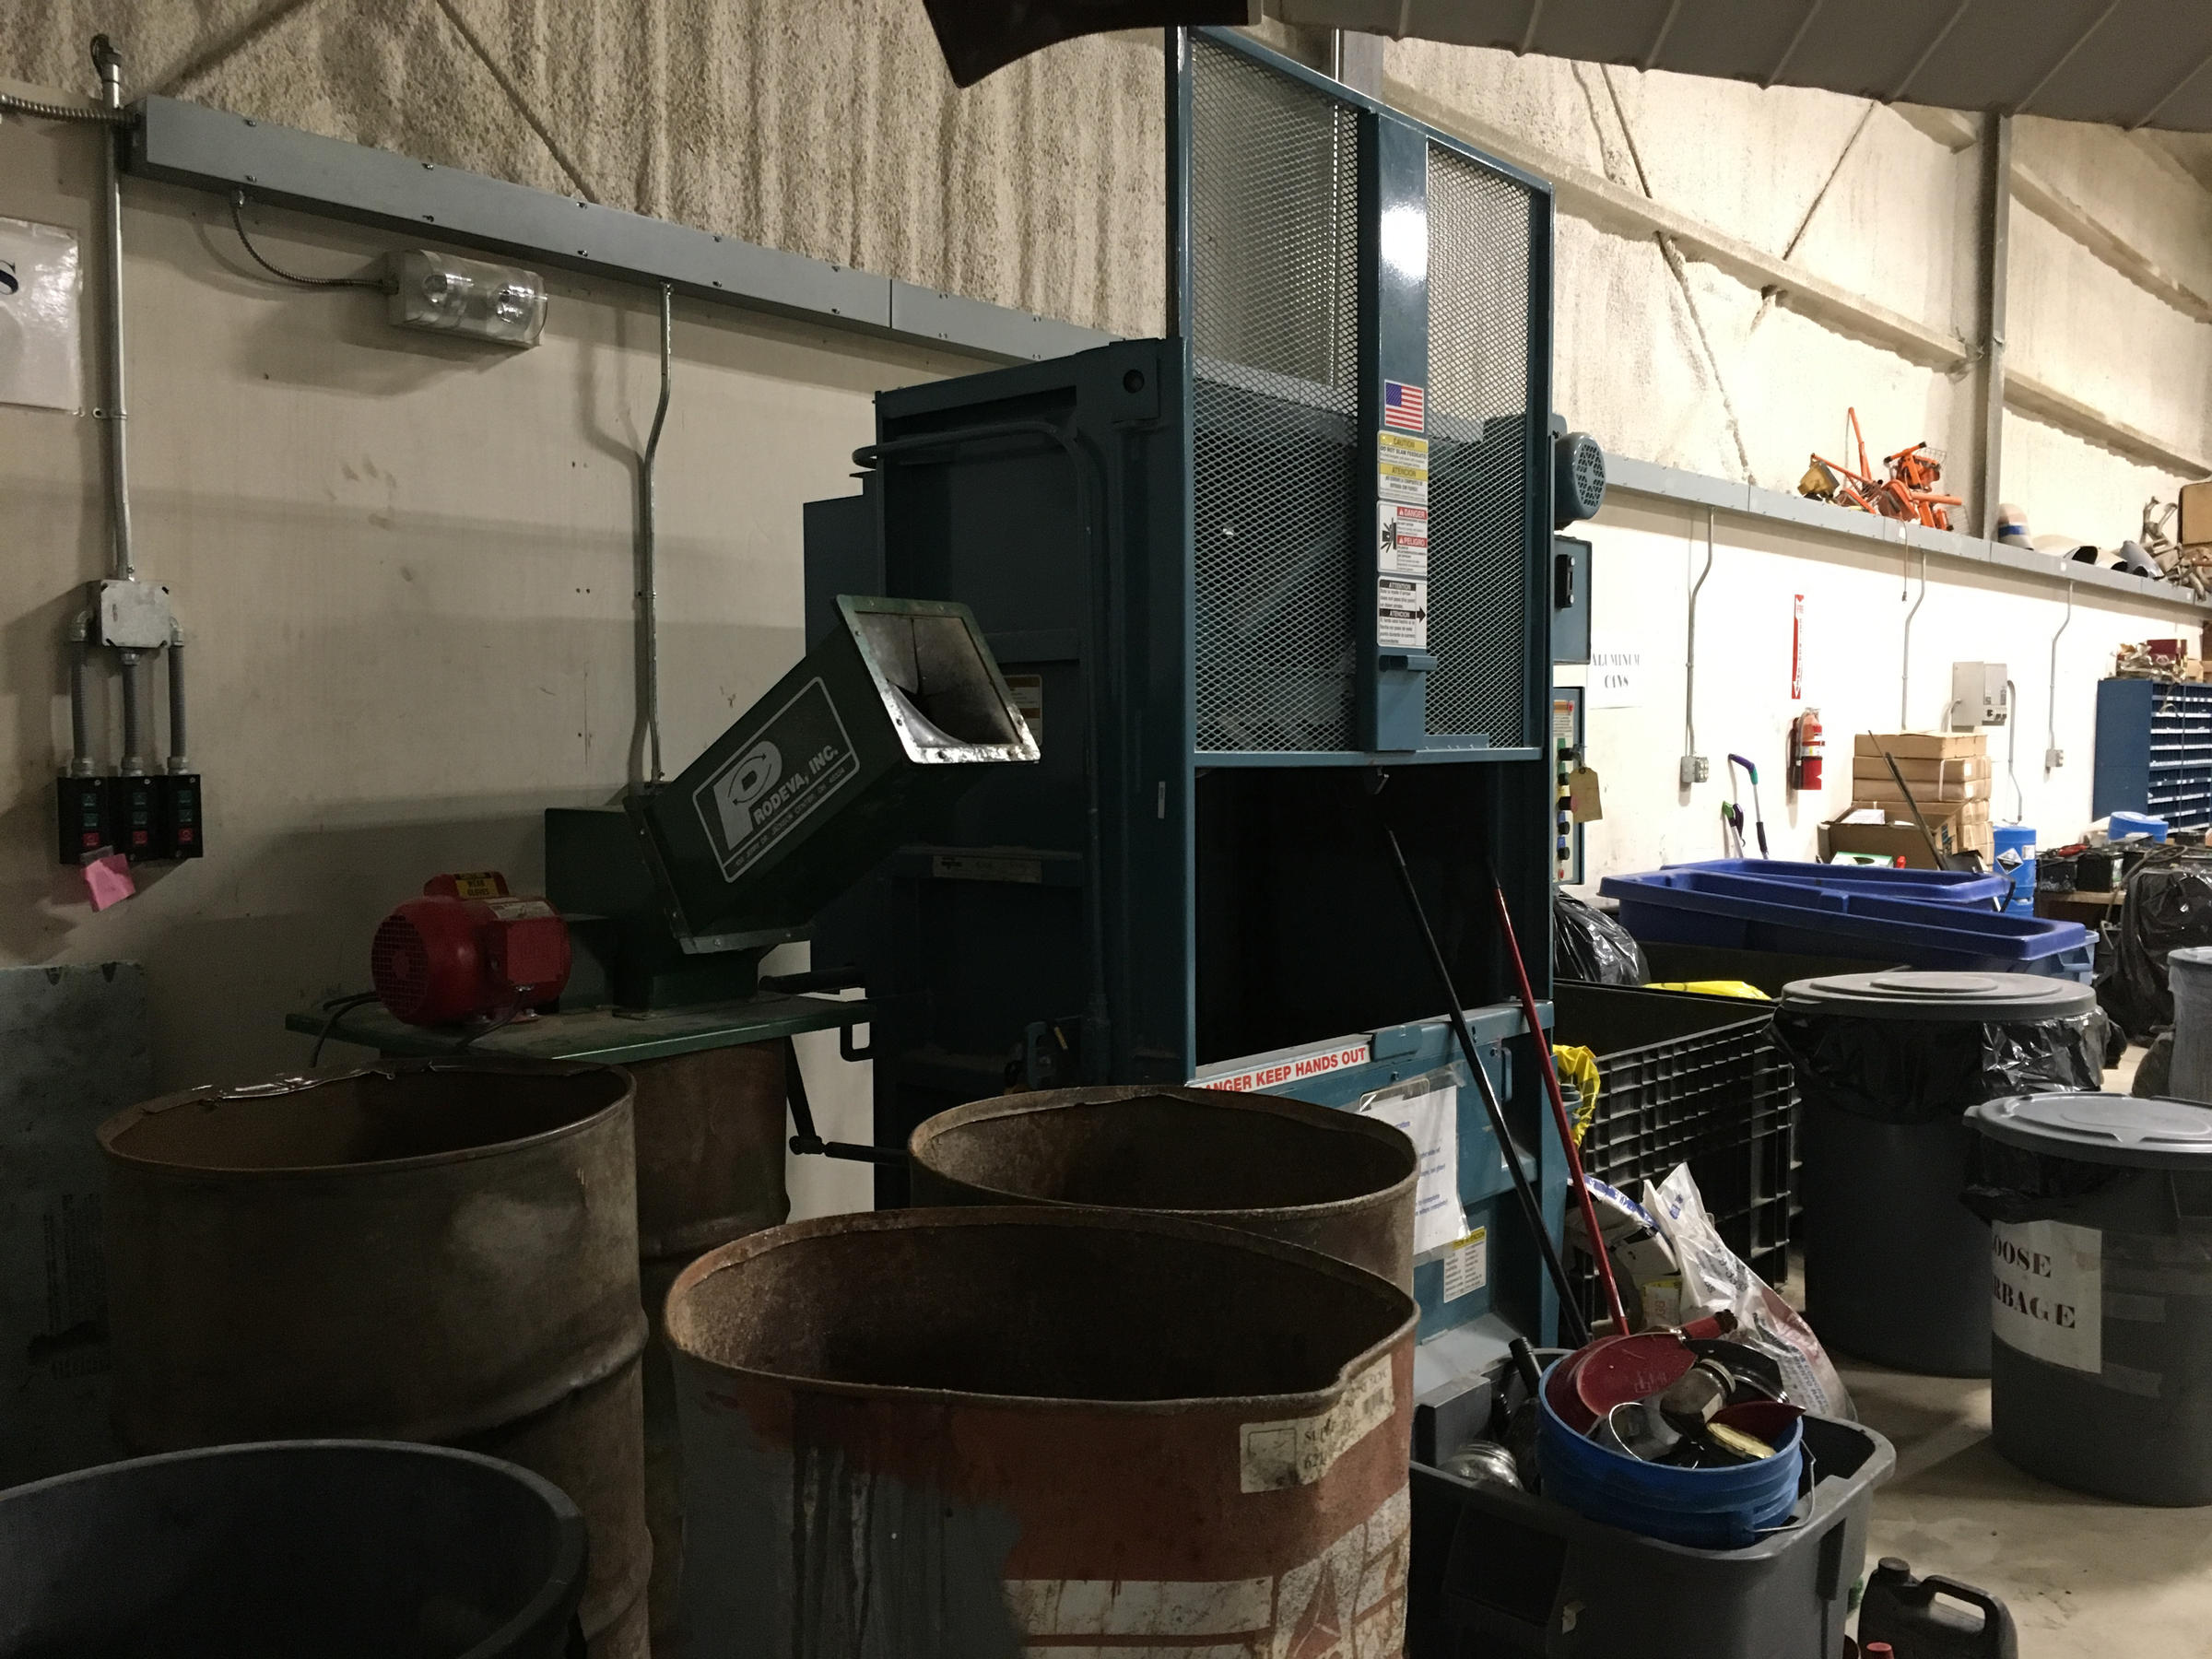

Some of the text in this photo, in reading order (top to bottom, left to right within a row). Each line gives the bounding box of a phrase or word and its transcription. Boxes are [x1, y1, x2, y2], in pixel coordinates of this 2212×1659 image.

[1404, 508, 1426, 519] DANGER
[1403, 536, 1426, 547] PELIGRO
[807, 745, 840, 775] INC.
[1255, 1065, 1292, 1087] KEEP
[1295, 1056, 1339, 1077] HANDS
[1342, 1048, 1366, 1065] OUT
